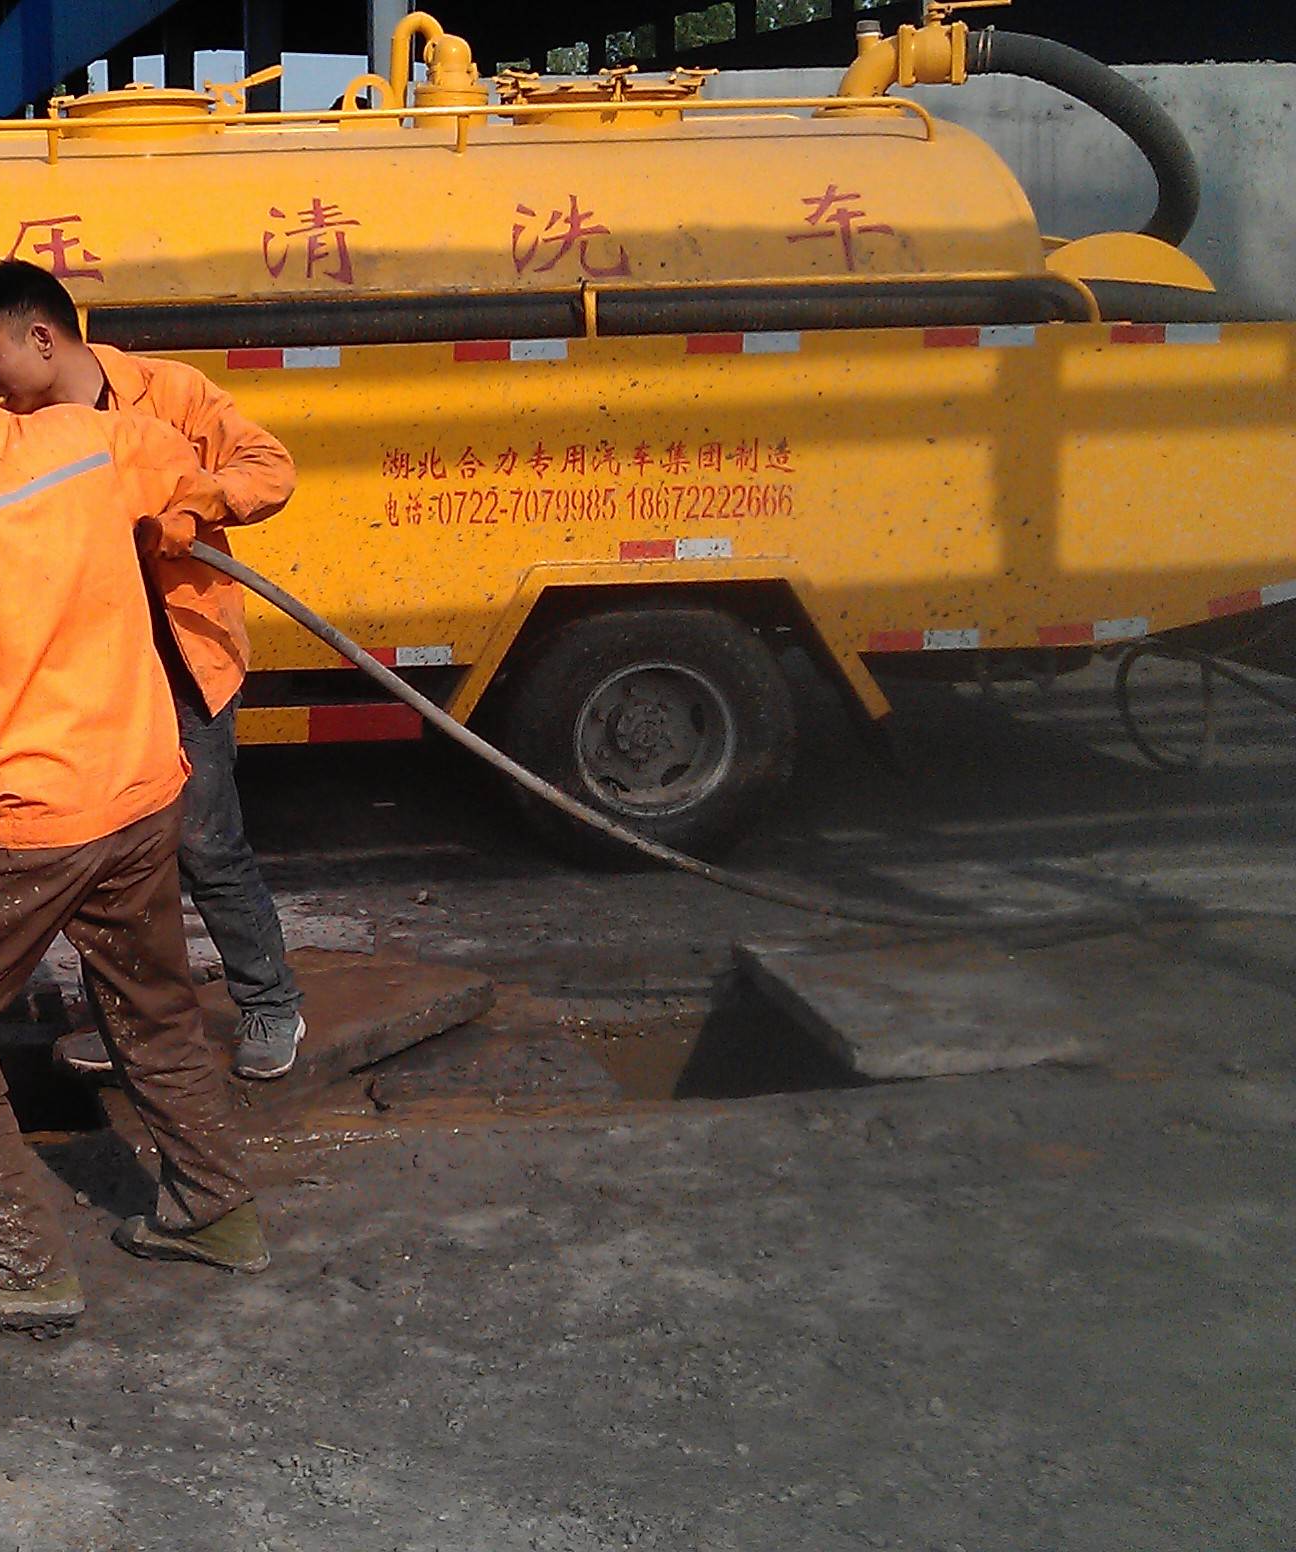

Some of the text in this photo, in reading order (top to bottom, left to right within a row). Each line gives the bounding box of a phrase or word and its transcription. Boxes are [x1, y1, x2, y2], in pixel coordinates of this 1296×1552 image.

[383, 437, 796, 480] 湖北合力专用汽车集团制造
[627, 483, 794, 521] 18672222666
